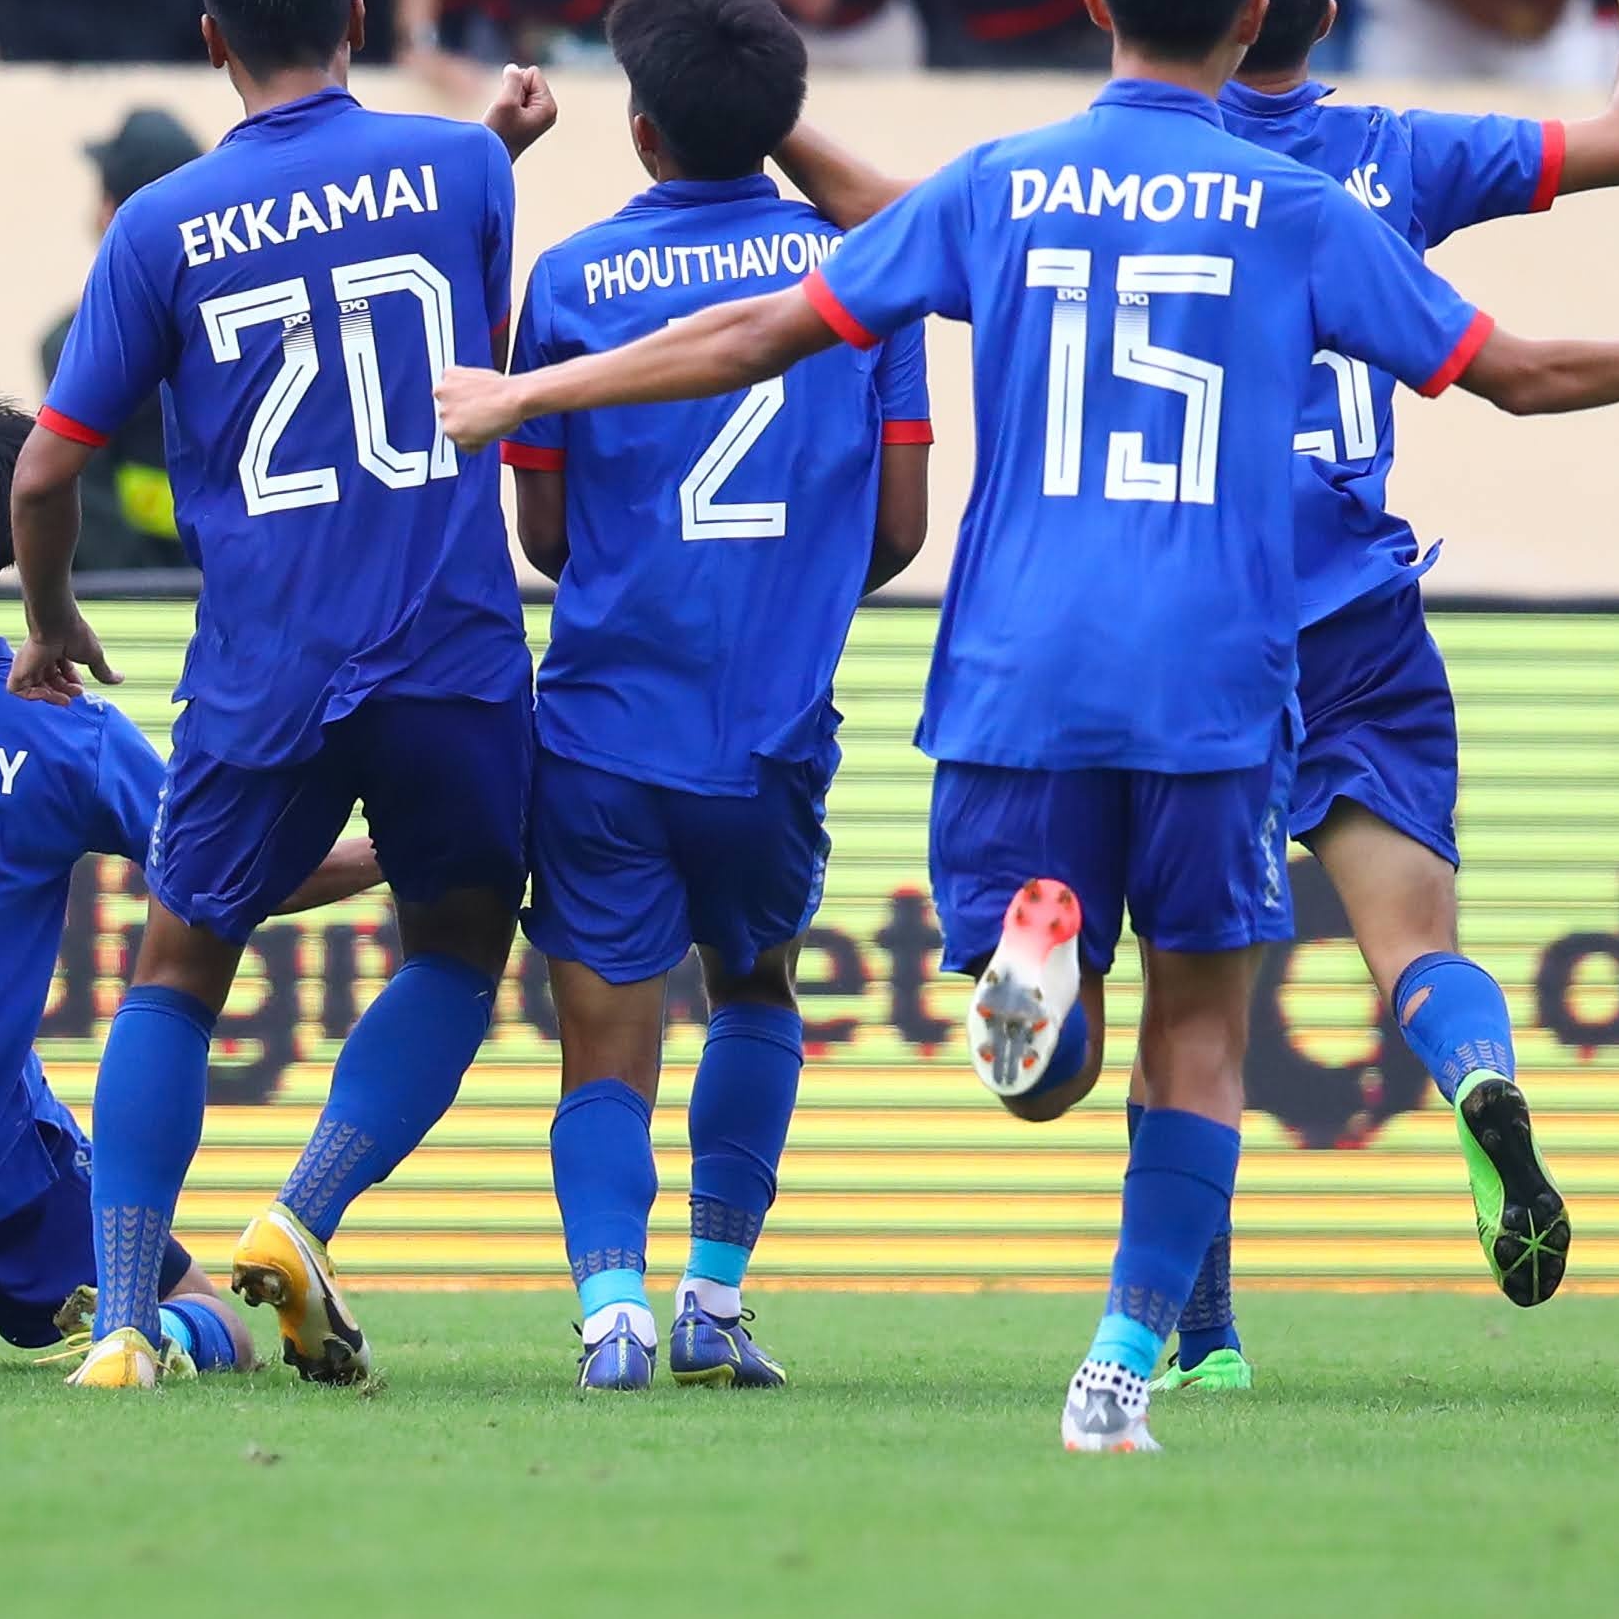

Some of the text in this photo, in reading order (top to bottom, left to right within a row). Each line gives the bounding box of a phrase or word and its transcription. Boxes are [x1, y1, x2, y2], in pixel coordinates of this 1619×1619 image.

[178, 164, 439, 268] EKKAMAI
[1010, 165, 1264, 229] DAMOTH
[198, 252, 460, 518] 20
[667, 318, 787, 542] 2
[1025, 248, 1235, 505] 15
